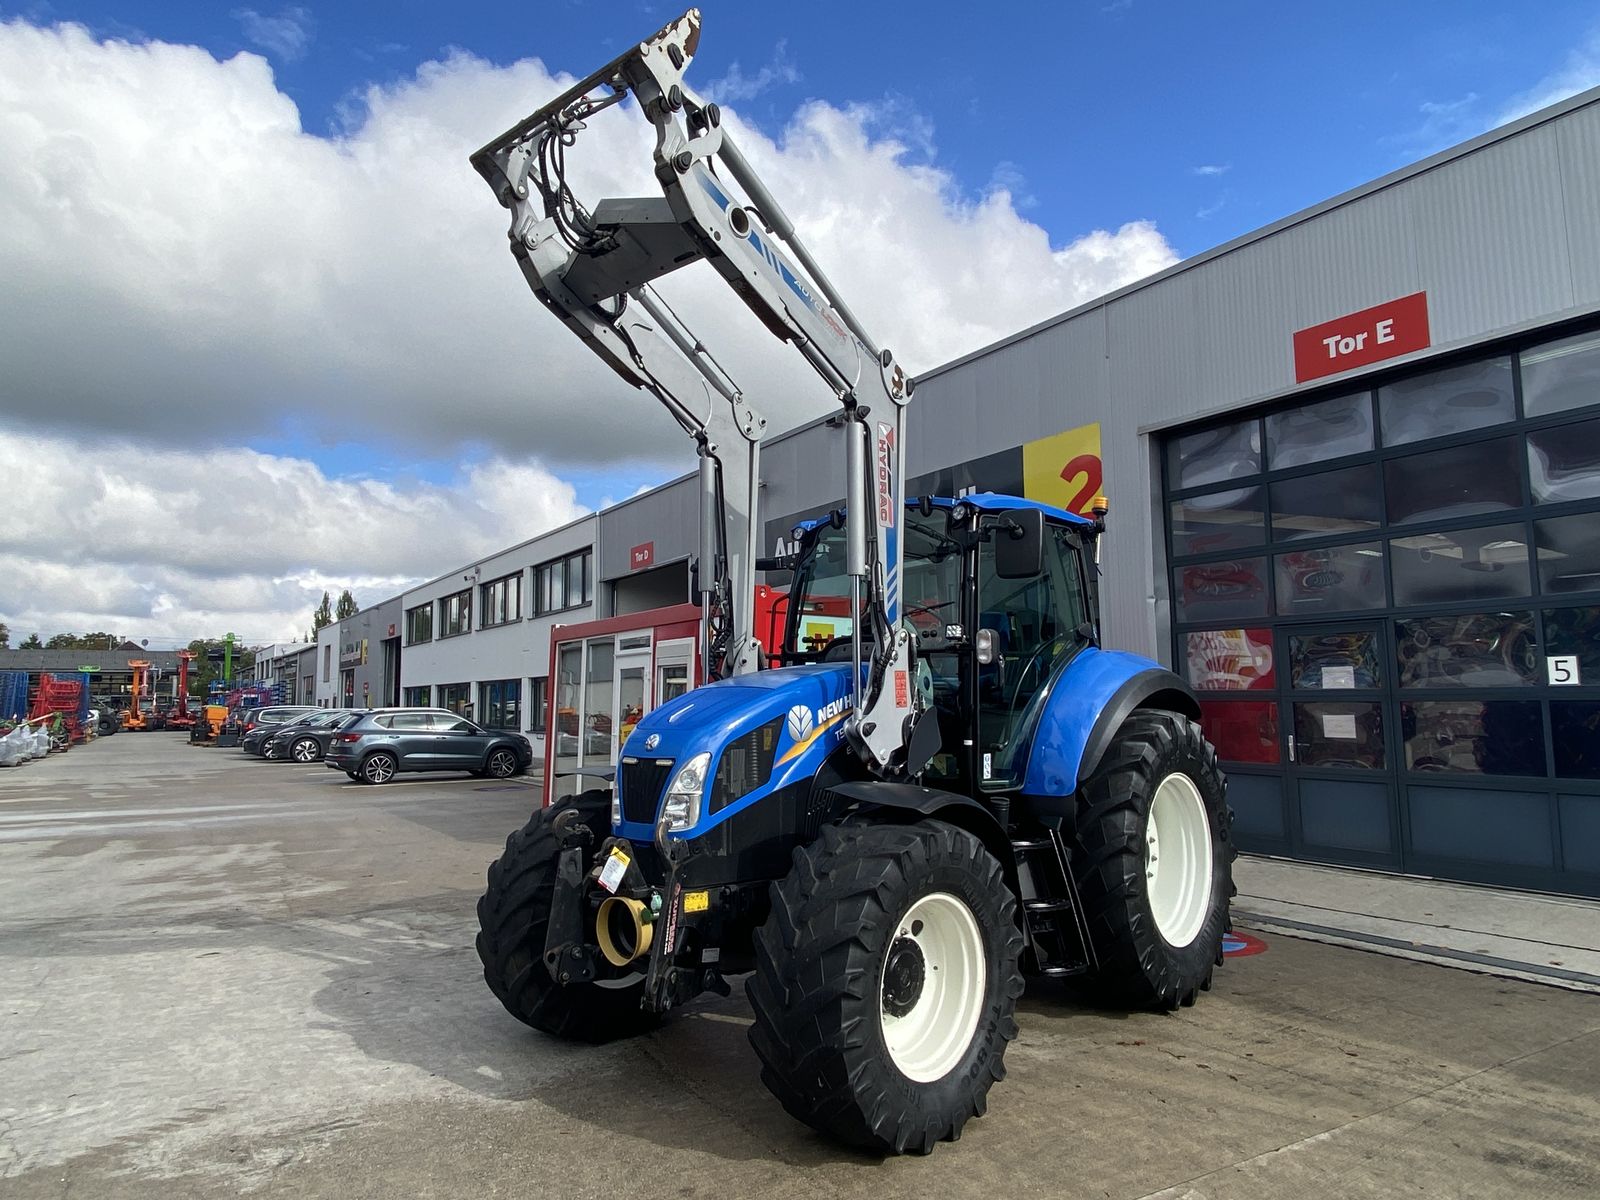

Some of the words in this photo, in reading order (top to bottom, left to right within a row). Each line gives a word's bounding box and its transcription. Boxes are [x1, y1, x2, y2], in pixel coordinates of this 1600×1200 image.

[1322, 331, 1368, 359] Tor
[1376, 318, 1395, 344] E
[879, 440, 888, 522] HYDRAC
[1060, 454, 1103, 521] 2
[635, 552, 643, 562] Tor
[643, 549, 649, 560] D
[1554, 660, 1571, 682] 5
[817, 697, 844, 724] NEW
